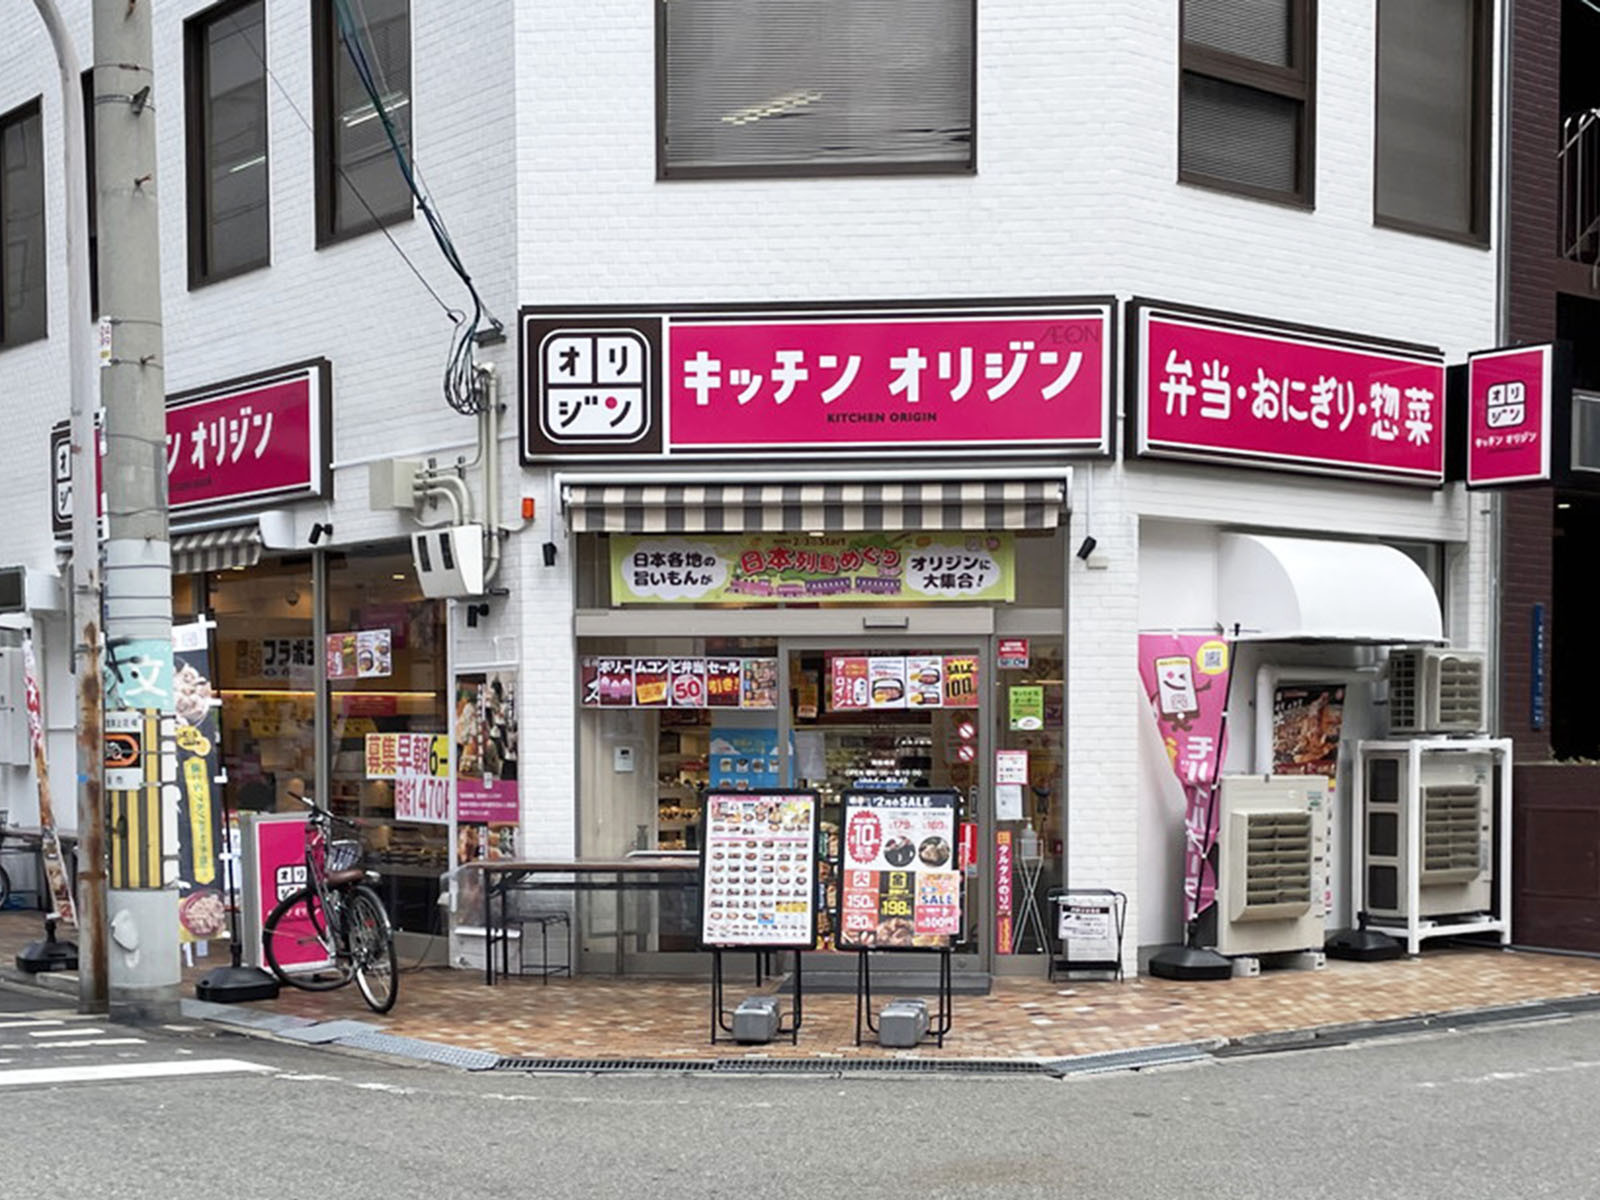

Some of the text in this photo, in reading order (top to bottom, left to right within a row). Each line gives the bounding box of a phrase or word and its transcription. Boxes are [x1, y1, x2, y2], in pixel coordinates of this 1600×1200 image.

[683, 340, 1083, 406] キッチン オリジン
[1159, 348, 1435, 446] 弁当・おにぎり・惣菜
[827, 411, 937, 424] KITCHEN ORIGIN
[191, 405, 273, 470] オリジン
[633, 552, 716, 568] 日本各地の
[911, 555, 991, 572] オリジンに
[633, 570, 713, 587] 旨いもんが
